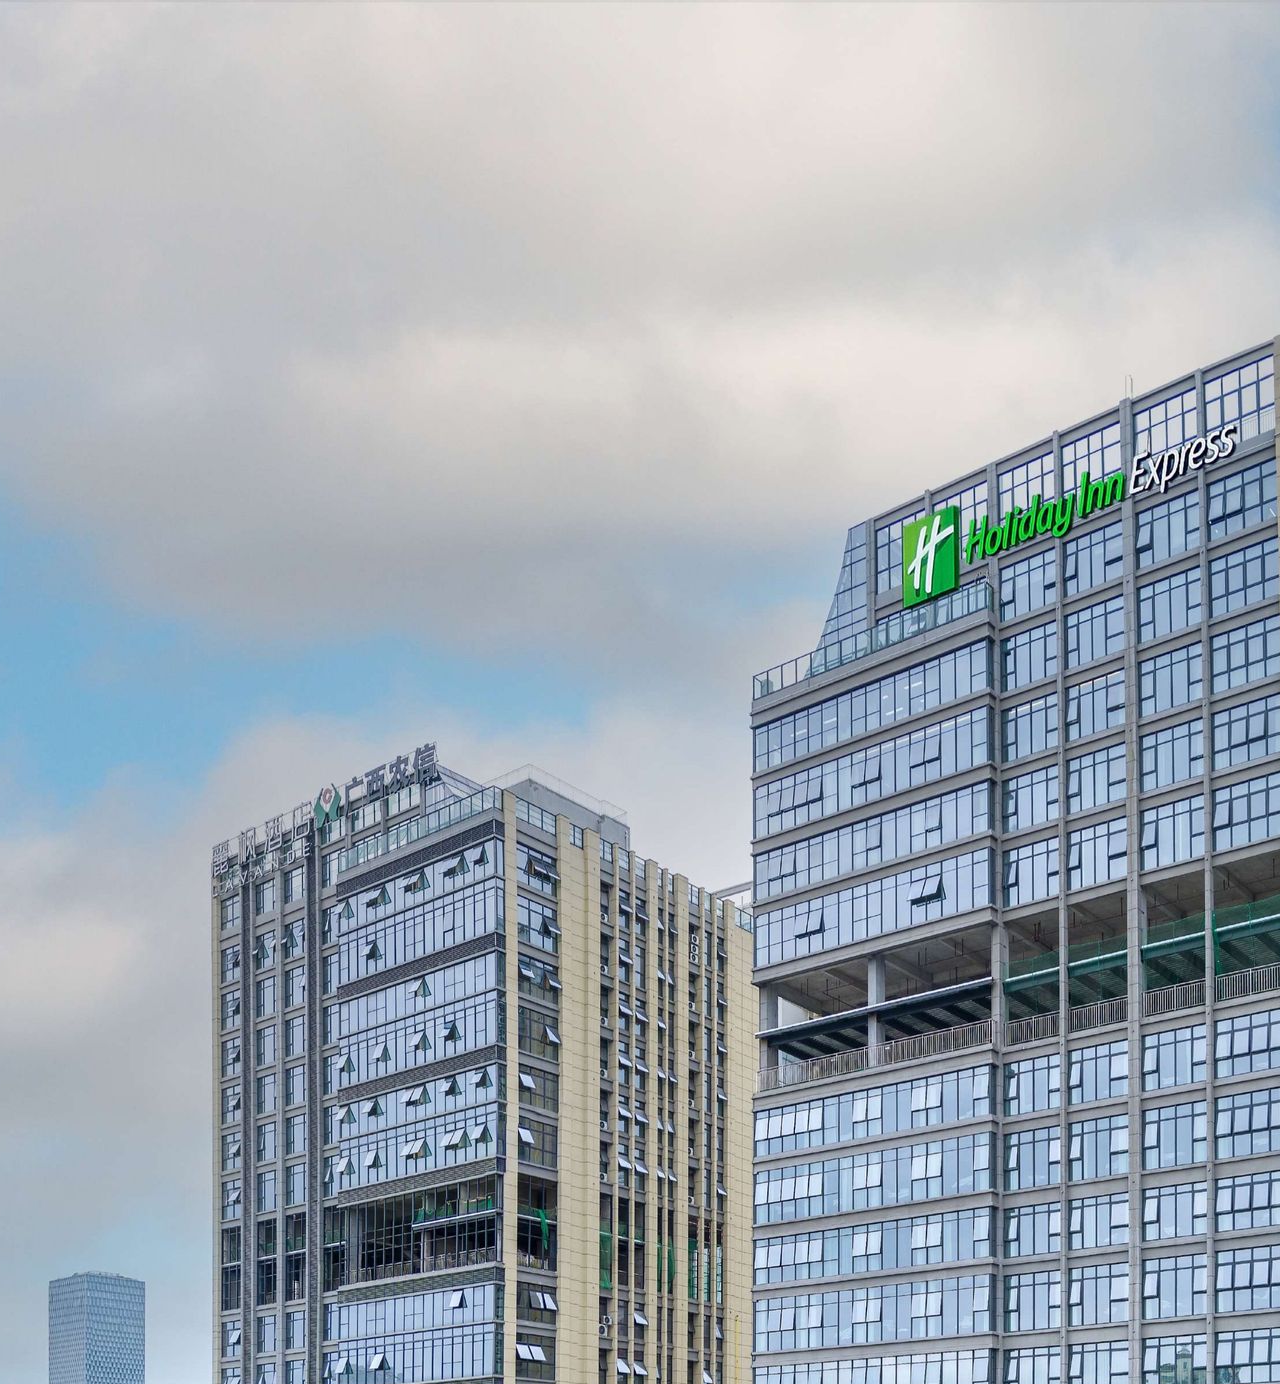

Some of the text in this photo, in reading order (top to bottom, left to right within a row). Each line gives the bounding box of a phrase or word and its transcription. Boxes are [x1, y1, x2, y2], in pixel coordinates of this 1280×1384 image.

[964, 493, 1074, 564] Holiday
[1077, 470, 1127, 518] Inn
[1129, 425, 1237, 495] Express
[345, 743, 438, 815] 广西农信
[212, 842, 313, 898] LAVANDE
